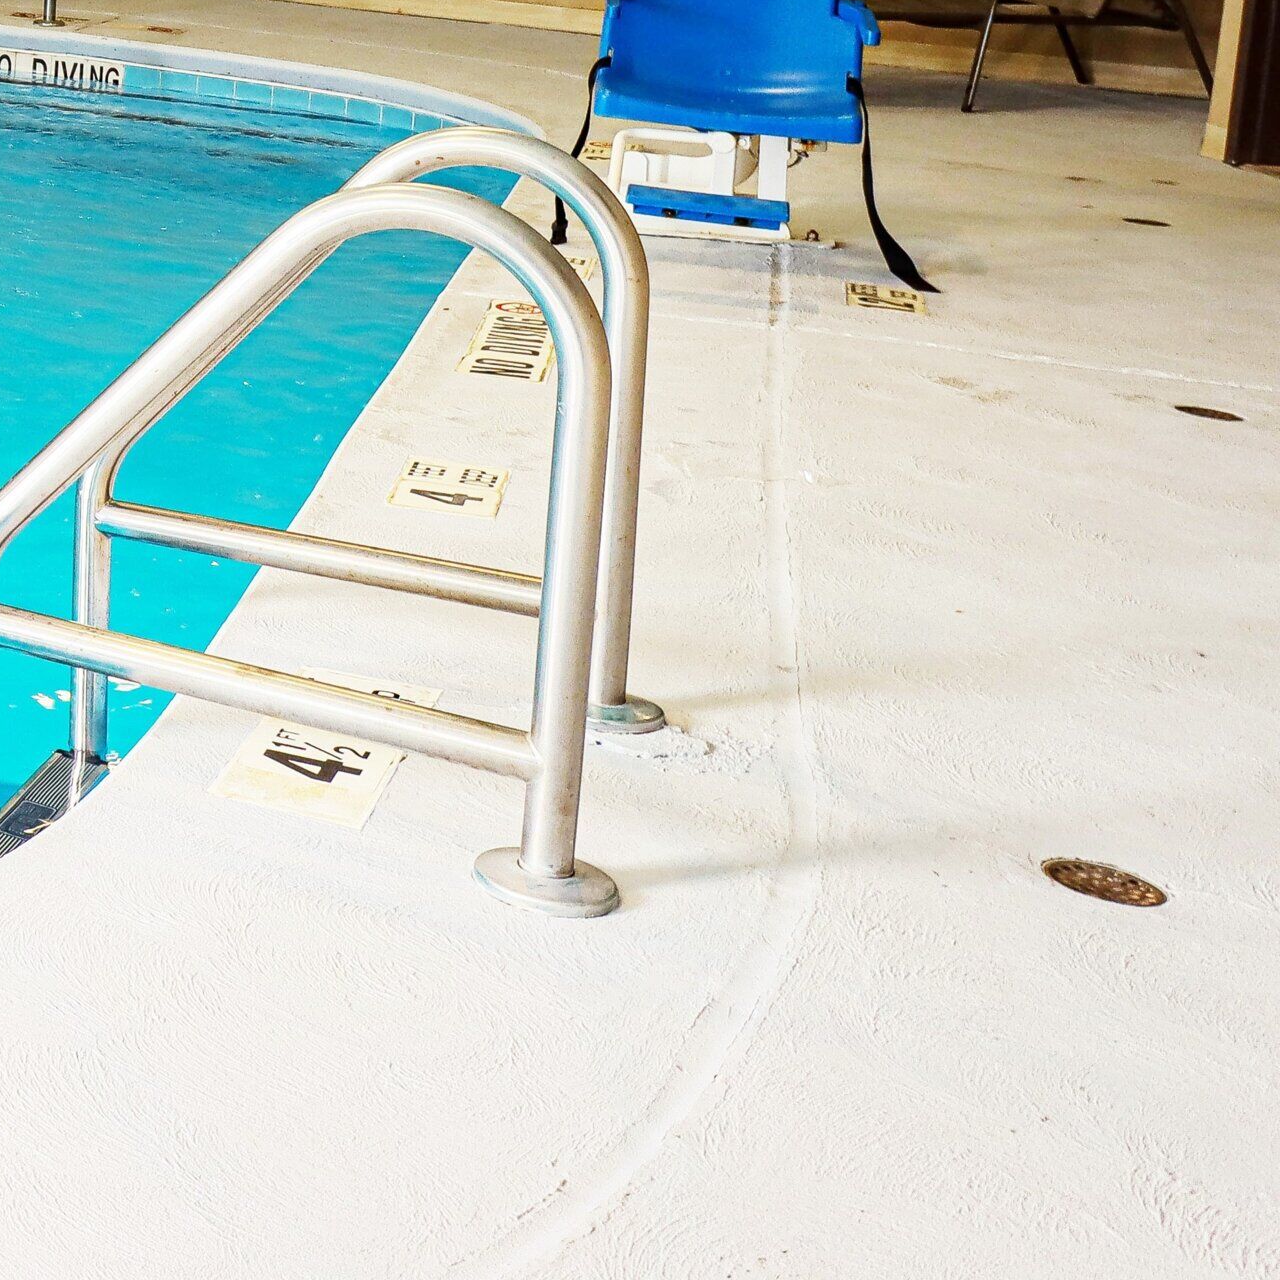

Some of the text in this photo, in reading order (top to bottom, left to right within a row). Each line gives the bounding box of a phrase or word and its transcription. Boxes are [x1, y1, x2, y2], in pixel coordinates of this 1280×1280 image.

[32, 58, 120, 86] DIVING
[470, 316, 548, 379] NO DIVING
[410, 488, 483, 506] 4
[263, 749, 363, 783] 4
